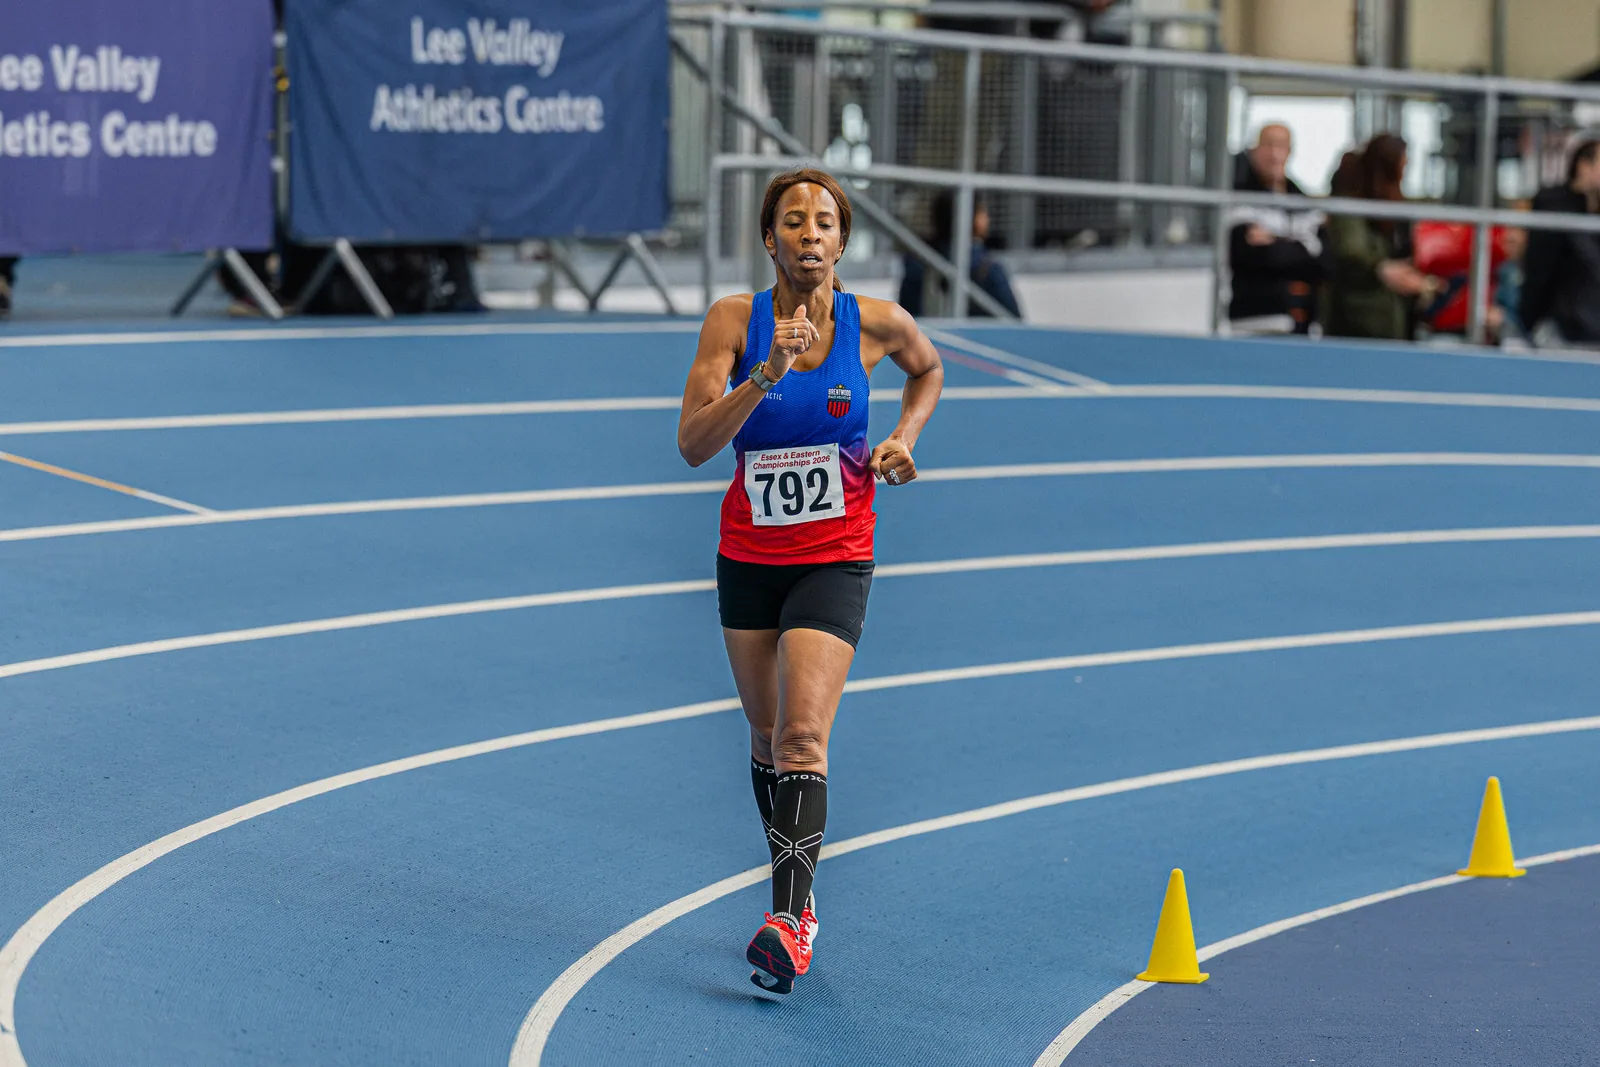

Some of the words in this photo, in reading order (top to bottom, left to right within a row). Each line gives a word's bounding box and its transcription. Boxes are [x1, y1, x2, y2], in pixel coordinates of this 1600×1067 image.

[411, 15, 466, 64] Lee
[467, 17, 564, 77] Valley
[50, 44, 161, 103] Valley
[370, 83, 502, 133] Athletics
[504, 84, 604, 133] Centre
[101, 110, 217, 157] Centre
[753, 459, 811, 470] Championships
[812, 455, 831, 465] 2026
[783, 452, 789, 460] &
[791, 450, 820, 458] Eastern
[755, 467, 832, 516] 792
